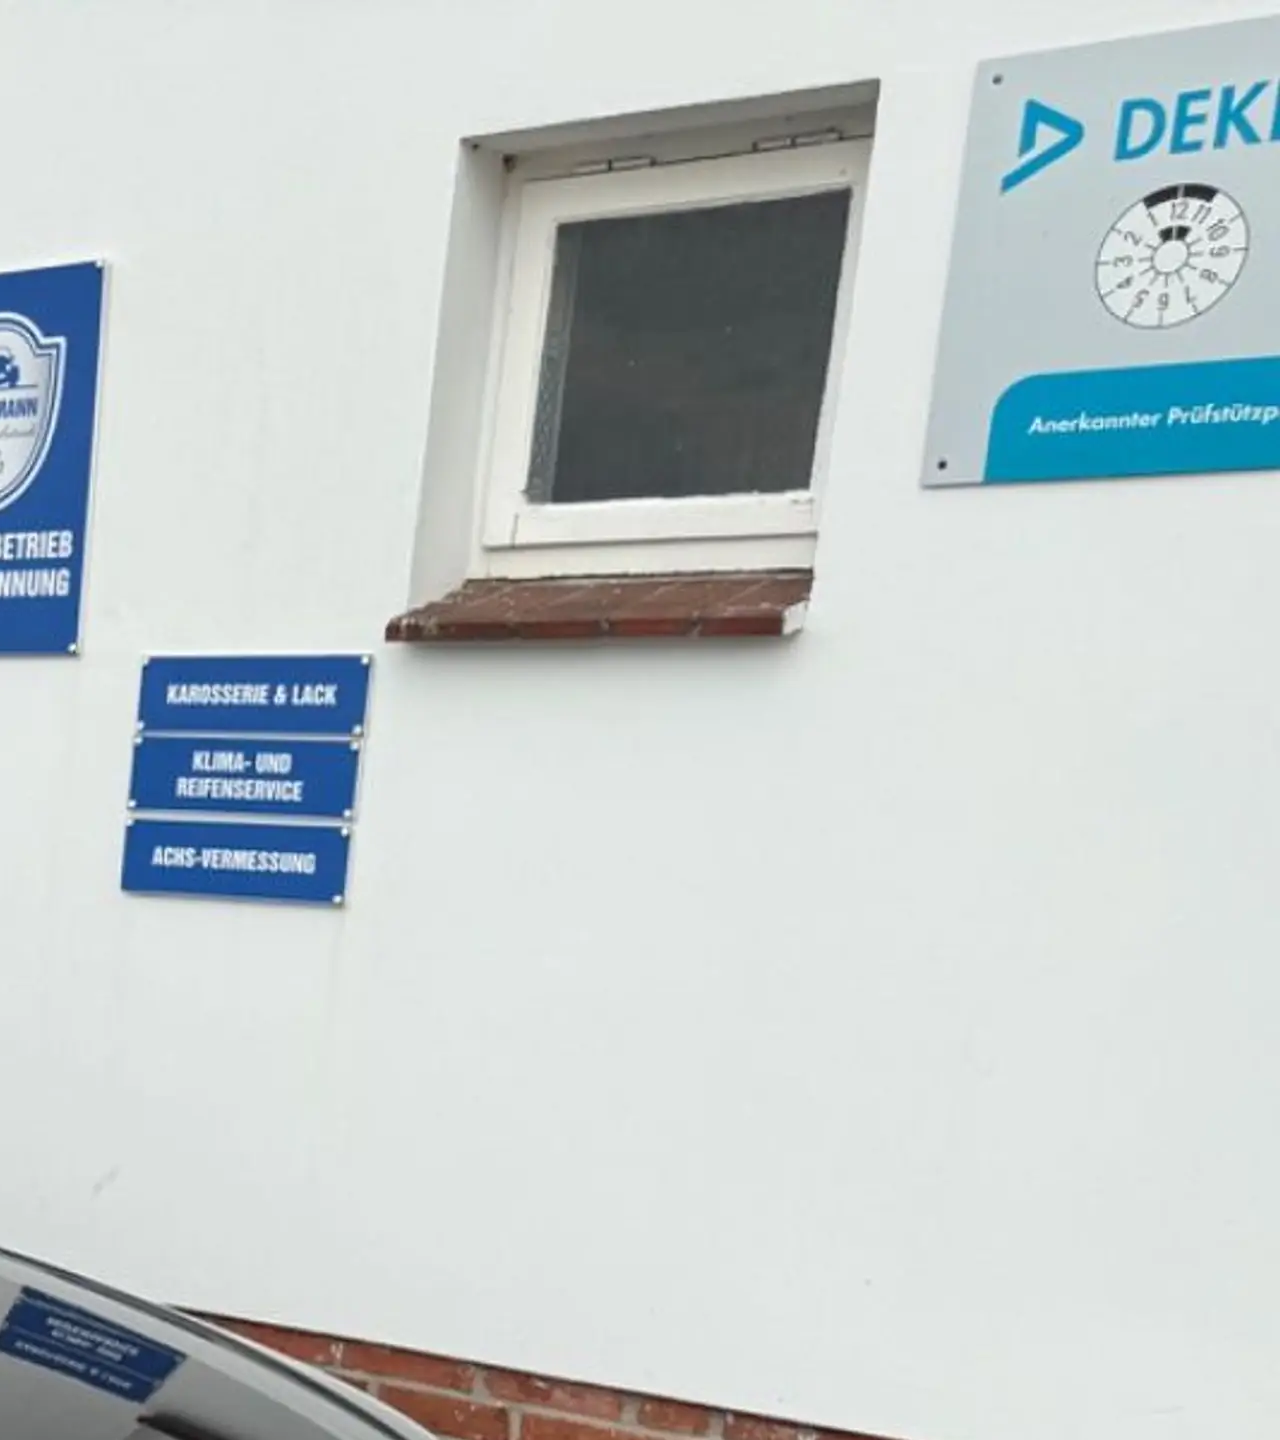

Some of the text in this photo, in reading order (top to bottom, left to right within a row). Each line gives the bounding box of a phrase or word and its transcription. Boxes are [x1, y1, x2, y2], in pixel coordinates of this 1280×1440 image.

[1113, 78, 1280, 162] DEK
[1170, 201, 1189, 221] 12
[1123, 231, 1143, 247] 2
[1205, 218, 1231, 242] 10
[1112, 255, 1134, 268] 3
[1199, 268, 1218, 284] 8
[1133, 289, 1150, 308] 5
[1156, 293, 1170, 311] 6
[1027, 411, 1162, 436] Anerkannter
[166, 683, 338, 706] KAROSSERIE & LACK
[192, 750, 293, 775] KLIMA- UND
[175, 776, 304, 803] REIFENSERVICE
[150, 845, 317, 875] ACHS-VERMESSUNG
